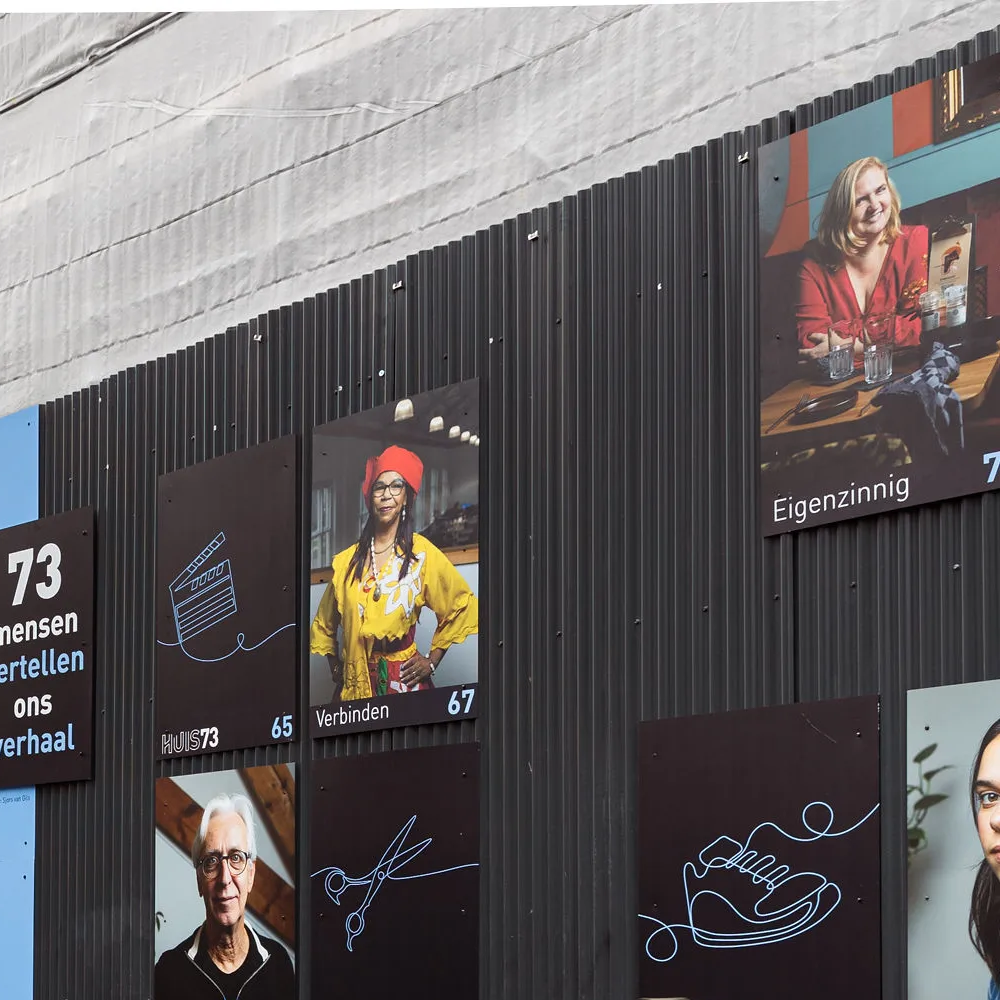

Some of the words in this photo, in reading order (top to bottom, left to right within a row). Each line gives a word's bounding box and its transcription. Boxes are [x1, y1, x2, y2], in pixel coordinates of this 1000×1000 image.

[773, 474, 910, 524] Eigenzinnig
[8, 543, 62, 606] 73
[13, 694, 53, 719] ons
[316, 702, 389, 728] Verbinden
[447, 688, 476, 715] 67
[161, 726, 219, 755] HUIS73
[271, 715, 293, 739] 65
